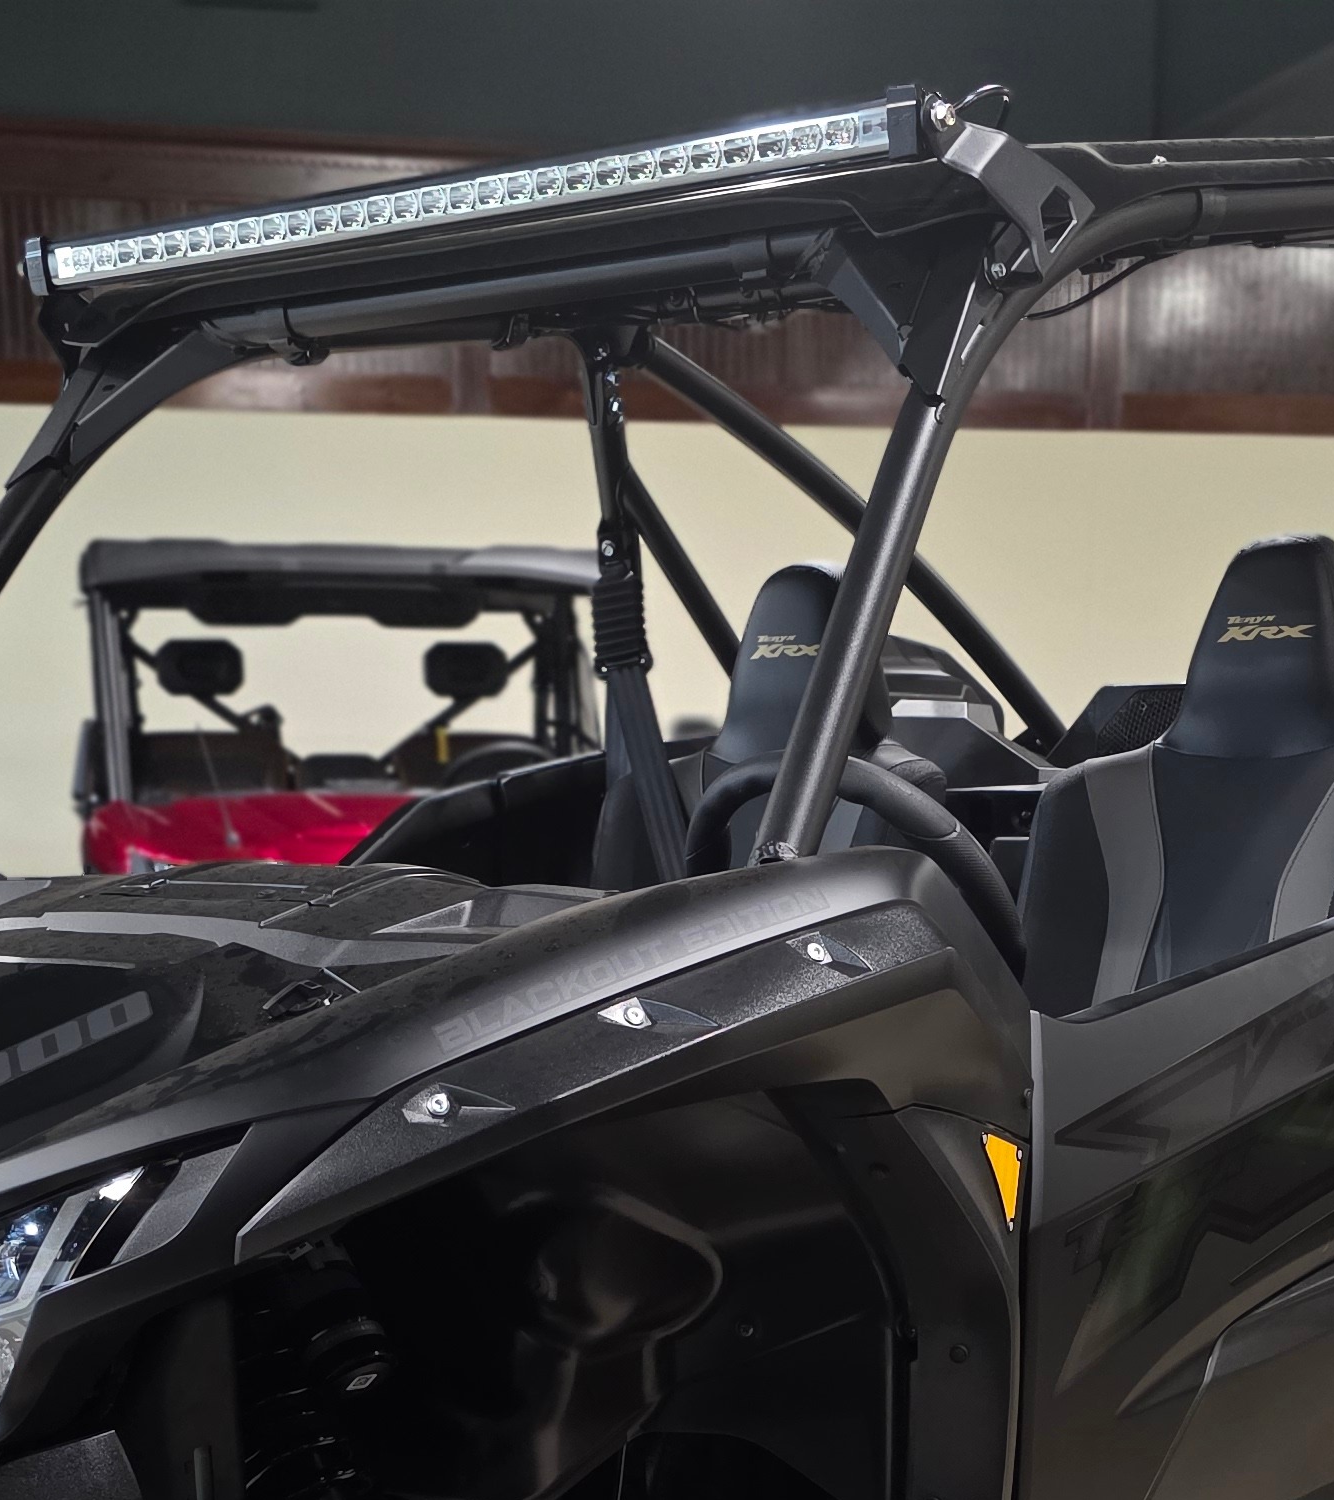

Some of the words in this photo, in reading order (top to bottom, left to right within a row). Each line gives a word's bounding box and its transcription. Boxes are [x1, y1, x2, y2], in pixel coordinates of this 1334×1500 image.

[1217, 624, 1317, 643] KRX
[750, 643, 821, 660] KRX
[430, 938, 665, 1056] BLACKOUT
[678, 888, 832, 961] EDITION
